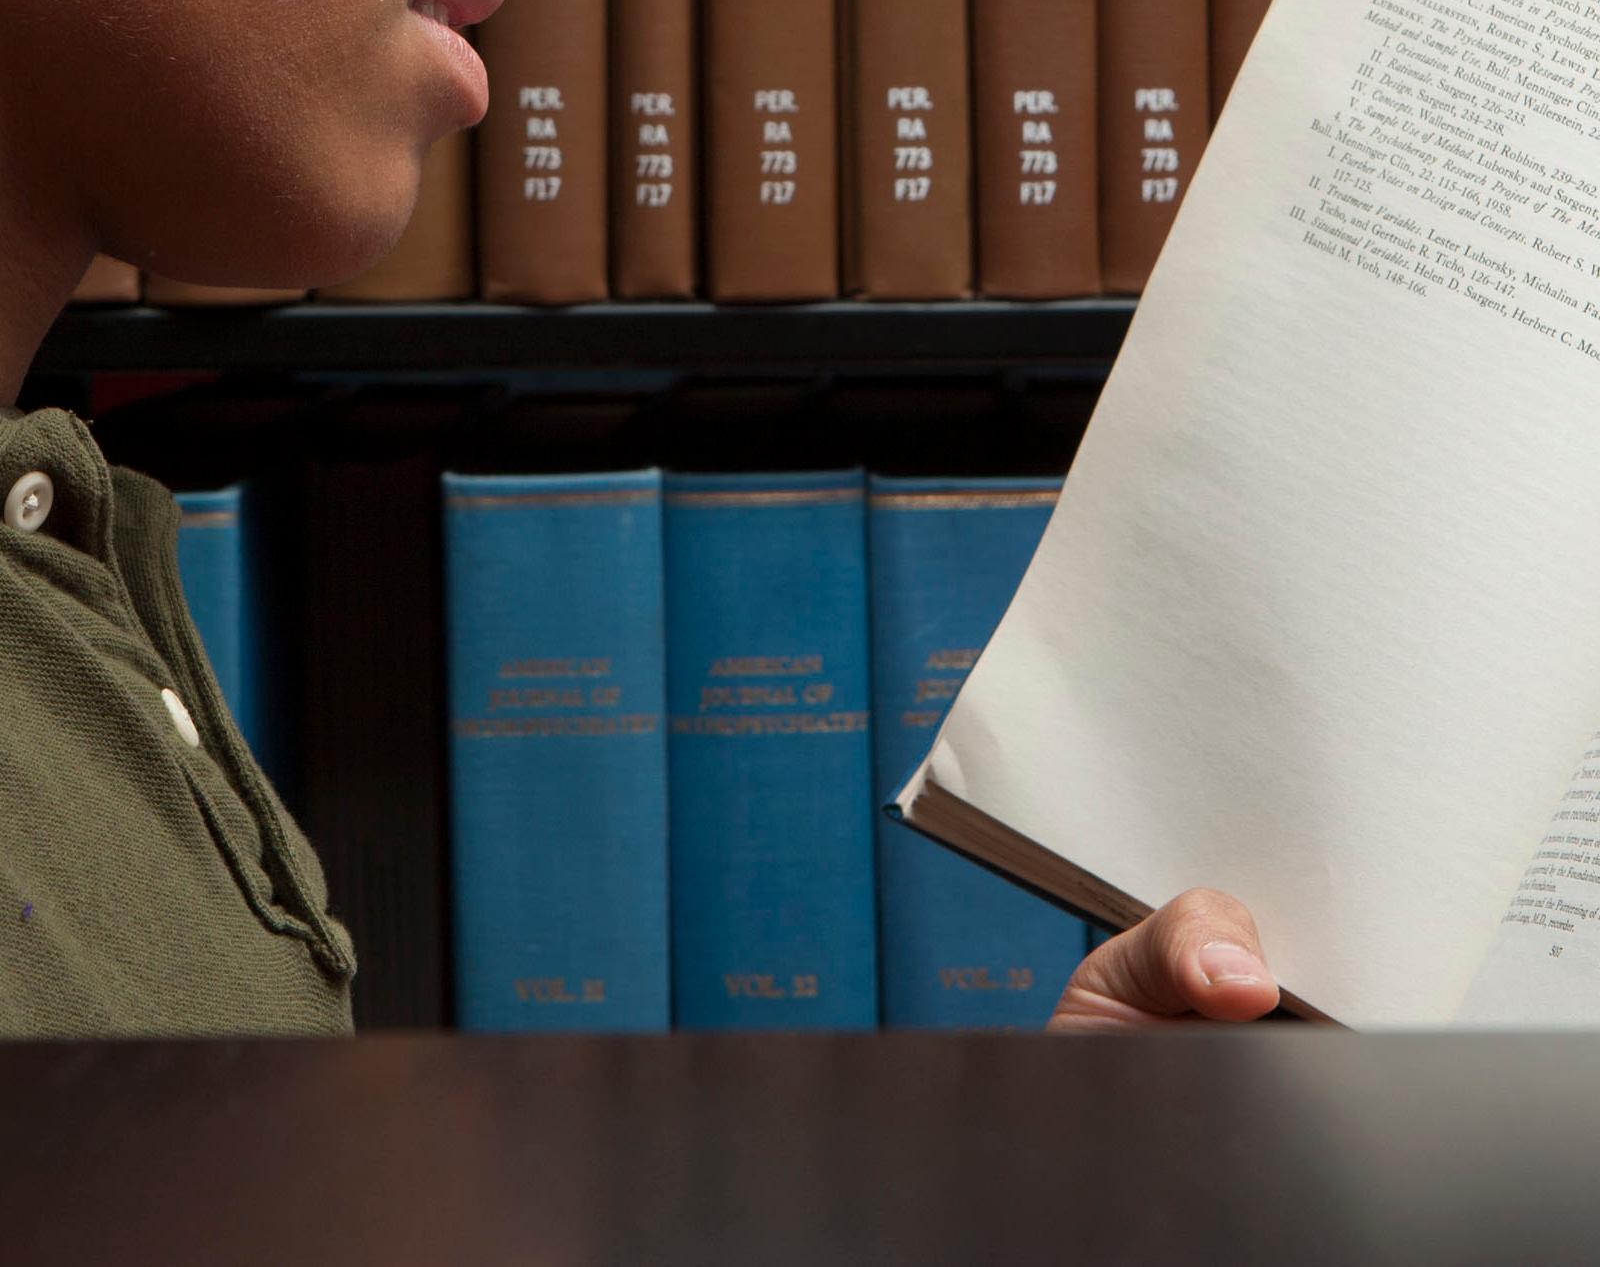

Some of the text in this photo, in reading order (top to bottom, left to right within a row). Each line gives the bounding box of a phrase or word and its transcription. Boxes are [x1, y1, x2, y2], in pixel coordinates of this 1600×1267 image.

[1485, 3, 1536, 34] American
[1452, 27, 1525, 68] Psychotherapy
[1528, 60, 1576, 89] Research
[1453, 65, 1497, 94] Robbins
[1514, 71, 1574, 108] Menninger
[527, 117, 557, 139] RA
[639, 123, 670, 146] RA
[763, 120, 792, 143] RA
[896, 117, 927, 140] RA
[1022, 120, 1053, 144] RA
[1144, 118, 1174, 142] RA
[1419, 107, 1475, 142] Wallerstein
[525, 146, 562, 170] 773
[894, 146, 933, 170] 773
[1334, 129, 1388, 161] Menninger
[637, 153, 674, 179] 773
[761, 150, 797, 175] 773
[1020, 149, 1058, 175] 773
[1141, 147, 1179, 172] 773
[1369, 126, 1438, 166] Psychotherapy
[1441, 158, 1488, 186] Research
[1490, 180, 1531, 205] Project
[1476, 153, 1529, 187] Luborsky
[524, 176, 562, 201] F17
[636, 182, 673, 207] F17
[760, 180, 796, 205] F17
[894, 176, 931, 202] F17
[1019, 179, 1057, 205] F17
[1141, 177, 1179, 203] F17
[1371, 223, 1417, 253] Gertrude
[1420, 187, 1457, 212] Design
[1531, 236, 1573, 265] Robert
[1302, 230, 1338, 255] Harold
[1426, 228, 1462, 253] Lester
[1521, 272, 1578, 309] Michalina
[1413, 261, 1445, 286] Helen
[1511, 307, 1558, 338] Herbert
